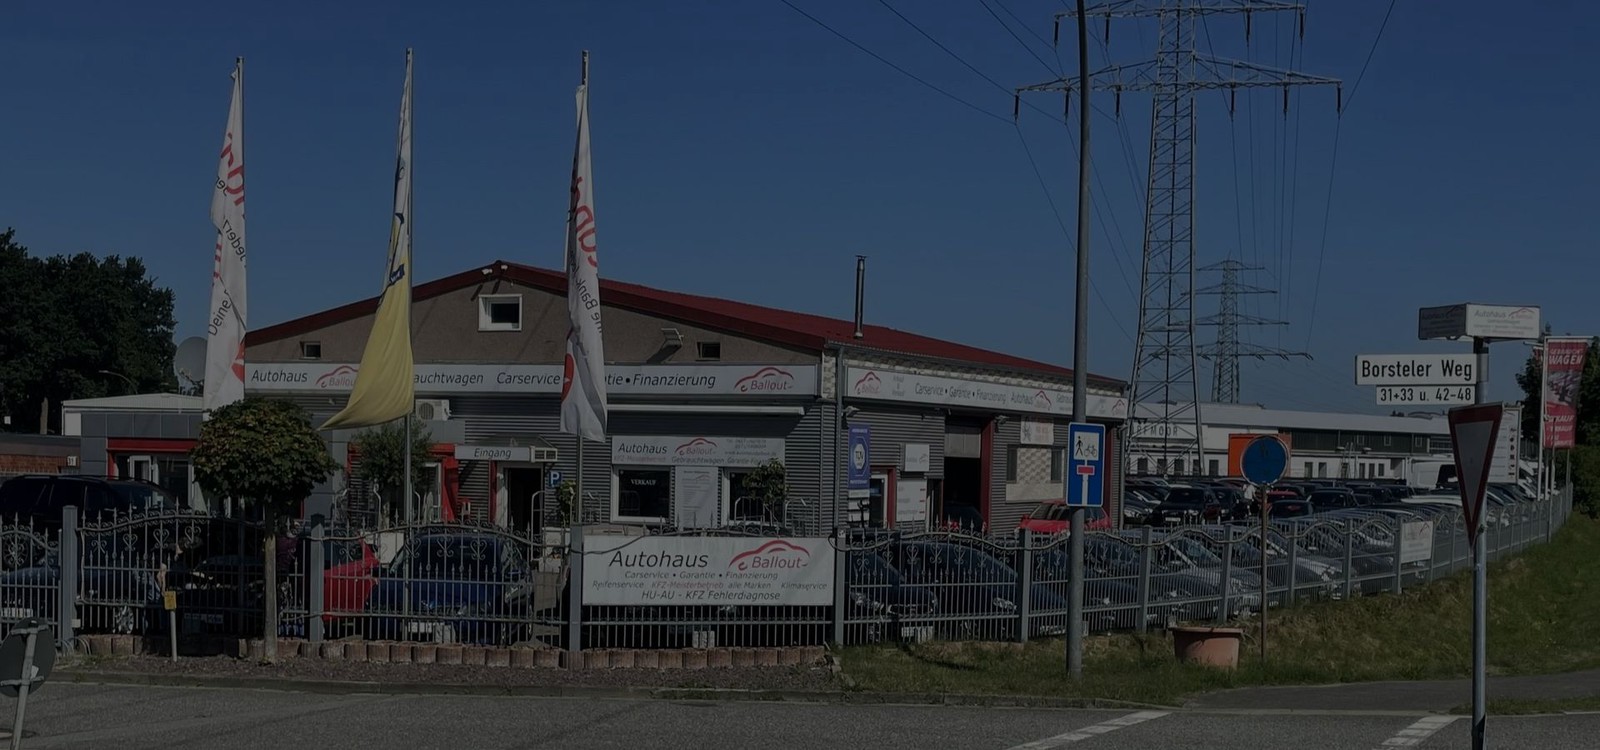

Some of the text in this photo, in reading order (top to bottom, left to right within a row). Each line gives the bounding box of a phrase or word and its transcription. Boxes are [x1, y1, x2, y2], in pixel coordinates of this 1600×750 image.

[208, 299, 231, 336] Deine
[1549, 355, 1583, 365] WAGEN
[1362, 360, 1472, 381] Borsteler Weg
[251, 370, 308, 383] Autohaus
[329, 377, 356, 387] Ballou
[414, 372, 484, 386] auchtwagen
[497, 372, 560, 385] Carservice
[633, 373, 716, 388] Finanzierung
[750, 380, 787, 391] Ballout
[915, 382, 943, 396] Carservice
[1380, 388, 1472, 401] 31+33 u. 42-48
[474, 448, 512, 459] Eingang
[618, 442, 713, 455] Autohaus Ballout
[671, 456, 725, 465] Gebrauchtwagen
[551, 472, 560, 484] P
[608, 550, 801, 569] Autohaus Ballout
[624, 571, 779, 580] Carservice Garantie Finanzierung
[592, 580, 828, 590] Reifenservice KFZ-Meisterbetrieb alle Marken Klimaservice
[641, 590, 675, 600] HU-AU
[685, 590, 705, 600] KFZ
[707, 590, 781, 602] Fehlerdiagnose
